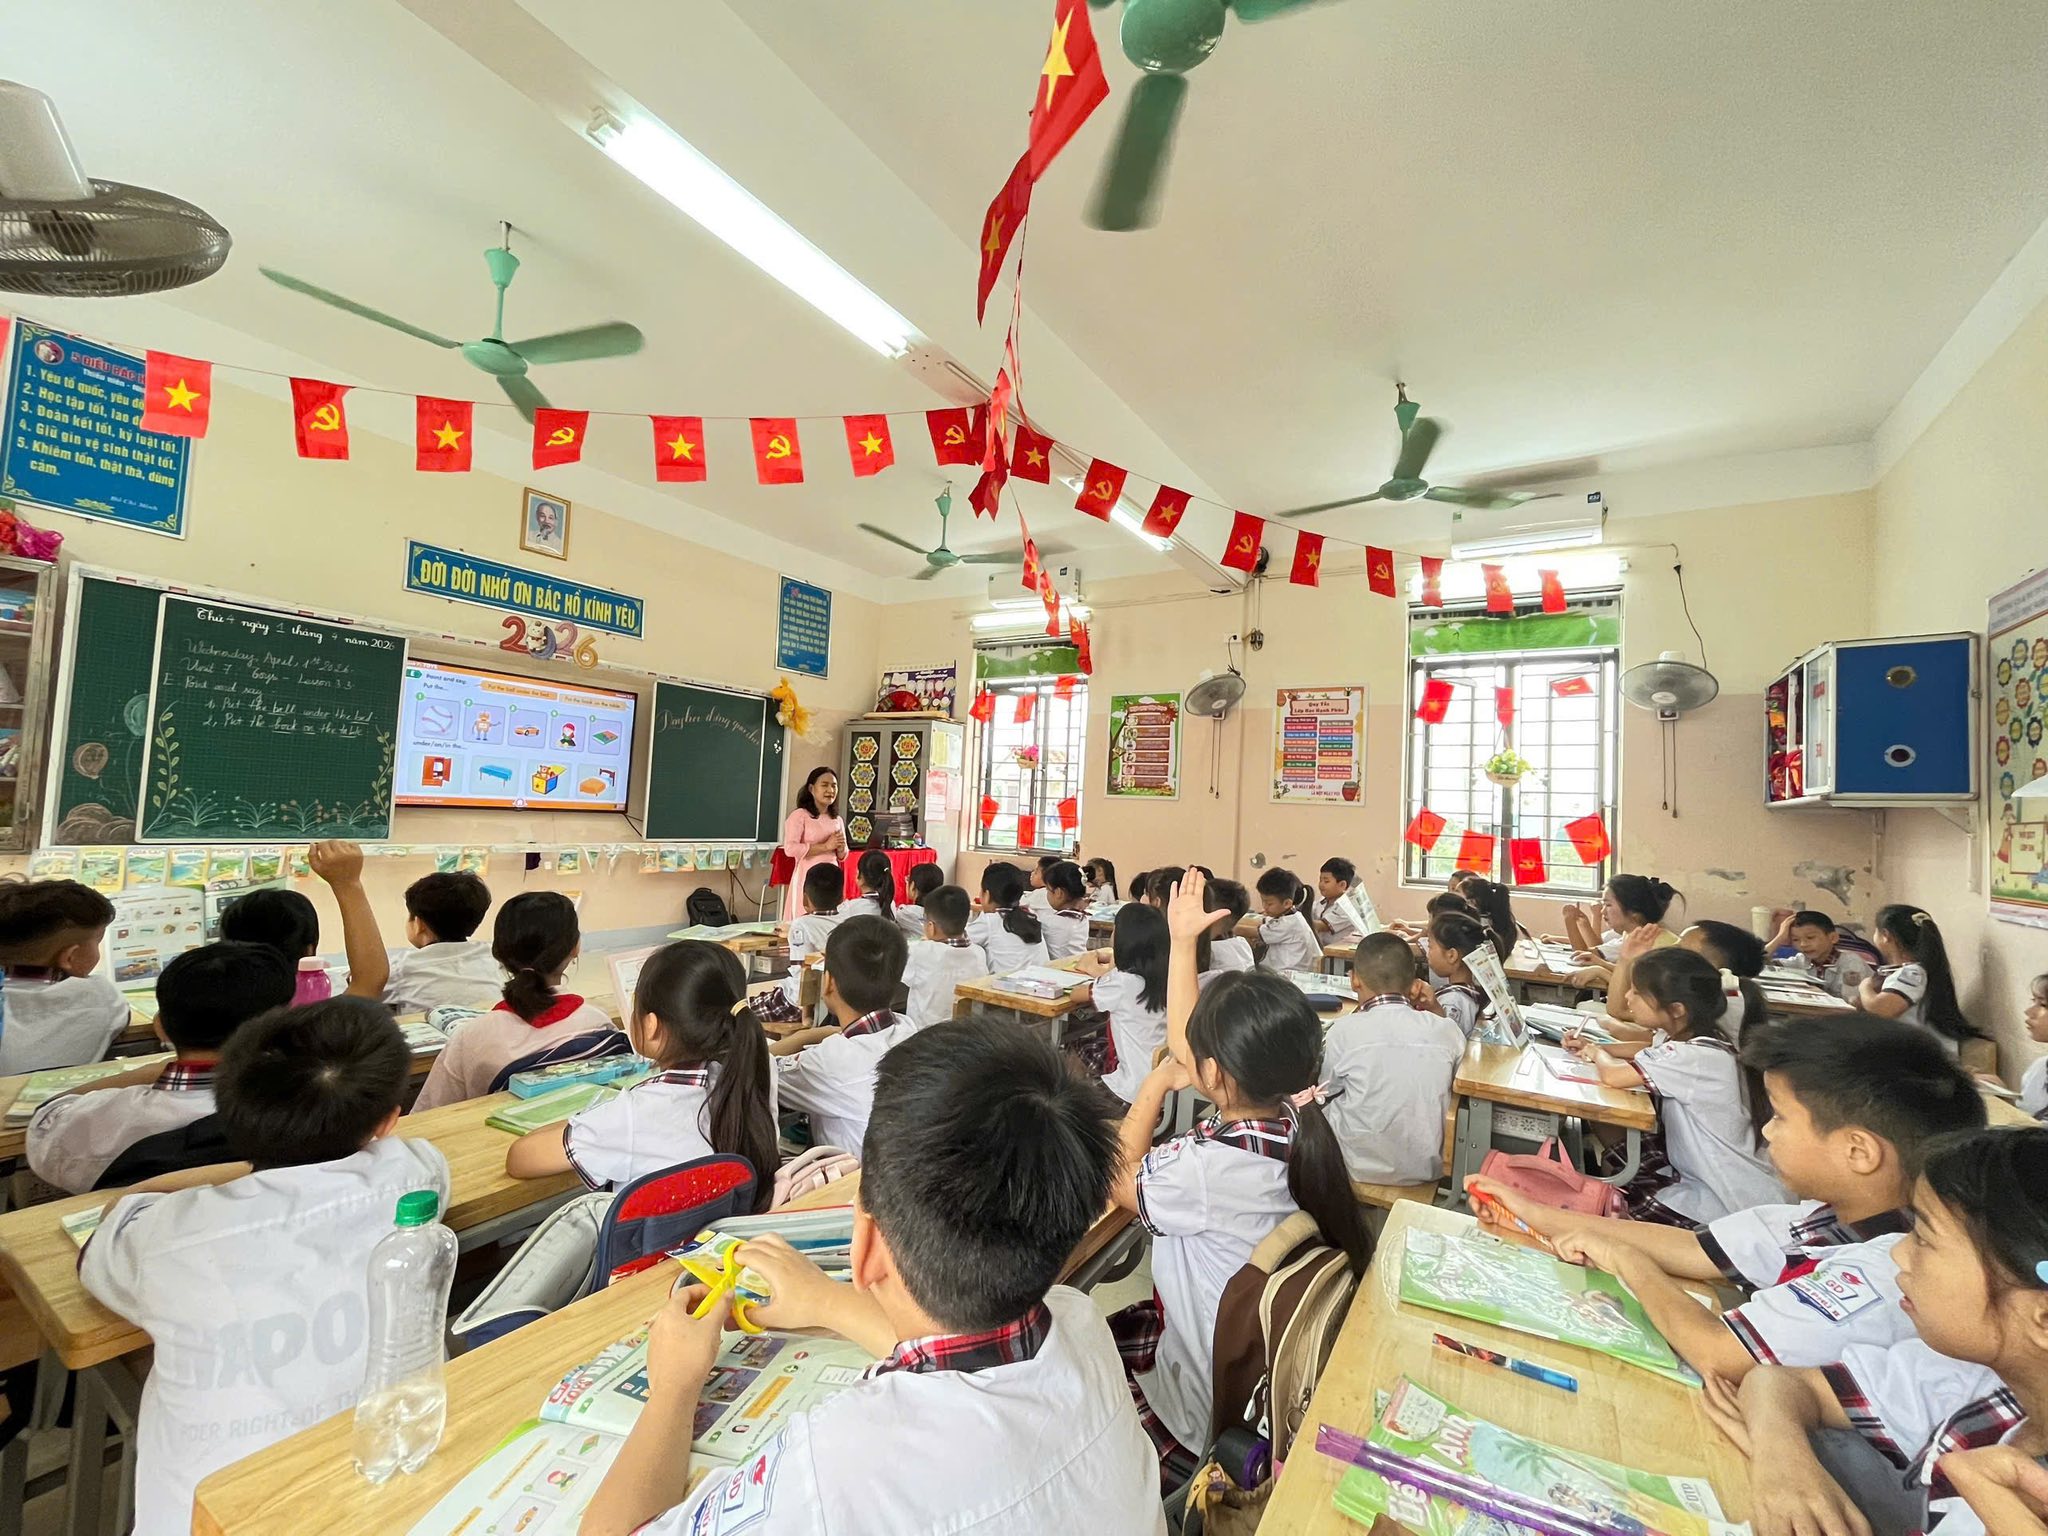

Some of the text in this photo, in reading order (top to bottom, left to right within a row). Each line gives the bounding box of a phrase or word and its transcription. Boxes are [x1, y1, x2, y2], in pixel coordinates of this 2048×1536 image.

[26, 364, 36, 377] 1.
[40, 368, 61, 384] Yêu
[111, 392, 129, 406] yêu
[21, 400, 33, 414] 3.
[37, 404, 69, 423] Đoàn
[73, 414, 92, 430] kết
[23, 382, 35, 395] 2.
[39, 387, 62, 404] Học
[66, 395, 85, 410] tập
[111, 408, 129, 423] lao
[19, 418, 32, 432] 4.
[103, 443, 128, 458] sinh
[132, 449, 155, 466] thật
[17, 436, 29, 449] 5.
[32, 440, 72, 460] Khiêm
[148, 471, 175, 488] dũng
[420, 556, 635, 629] ĐỜI ĐỜI NHỚ ƠN BÁC HỒ KÍNH YÊU
[241, 620, 269, 635] ngày
[292, 625, 323, 644] tháng
[345, 638, 369, 647] năm
[370, 638, 395, 650] 2026
[221, 697, 240, 711] Put
[248, 698, 266, 711] the
[224, 712, 242, 726] Put
[249, 714, 265, 727] the
[1826, 1280, 1844, 1294] GD
[729, 1470, 745, 1499] GD
